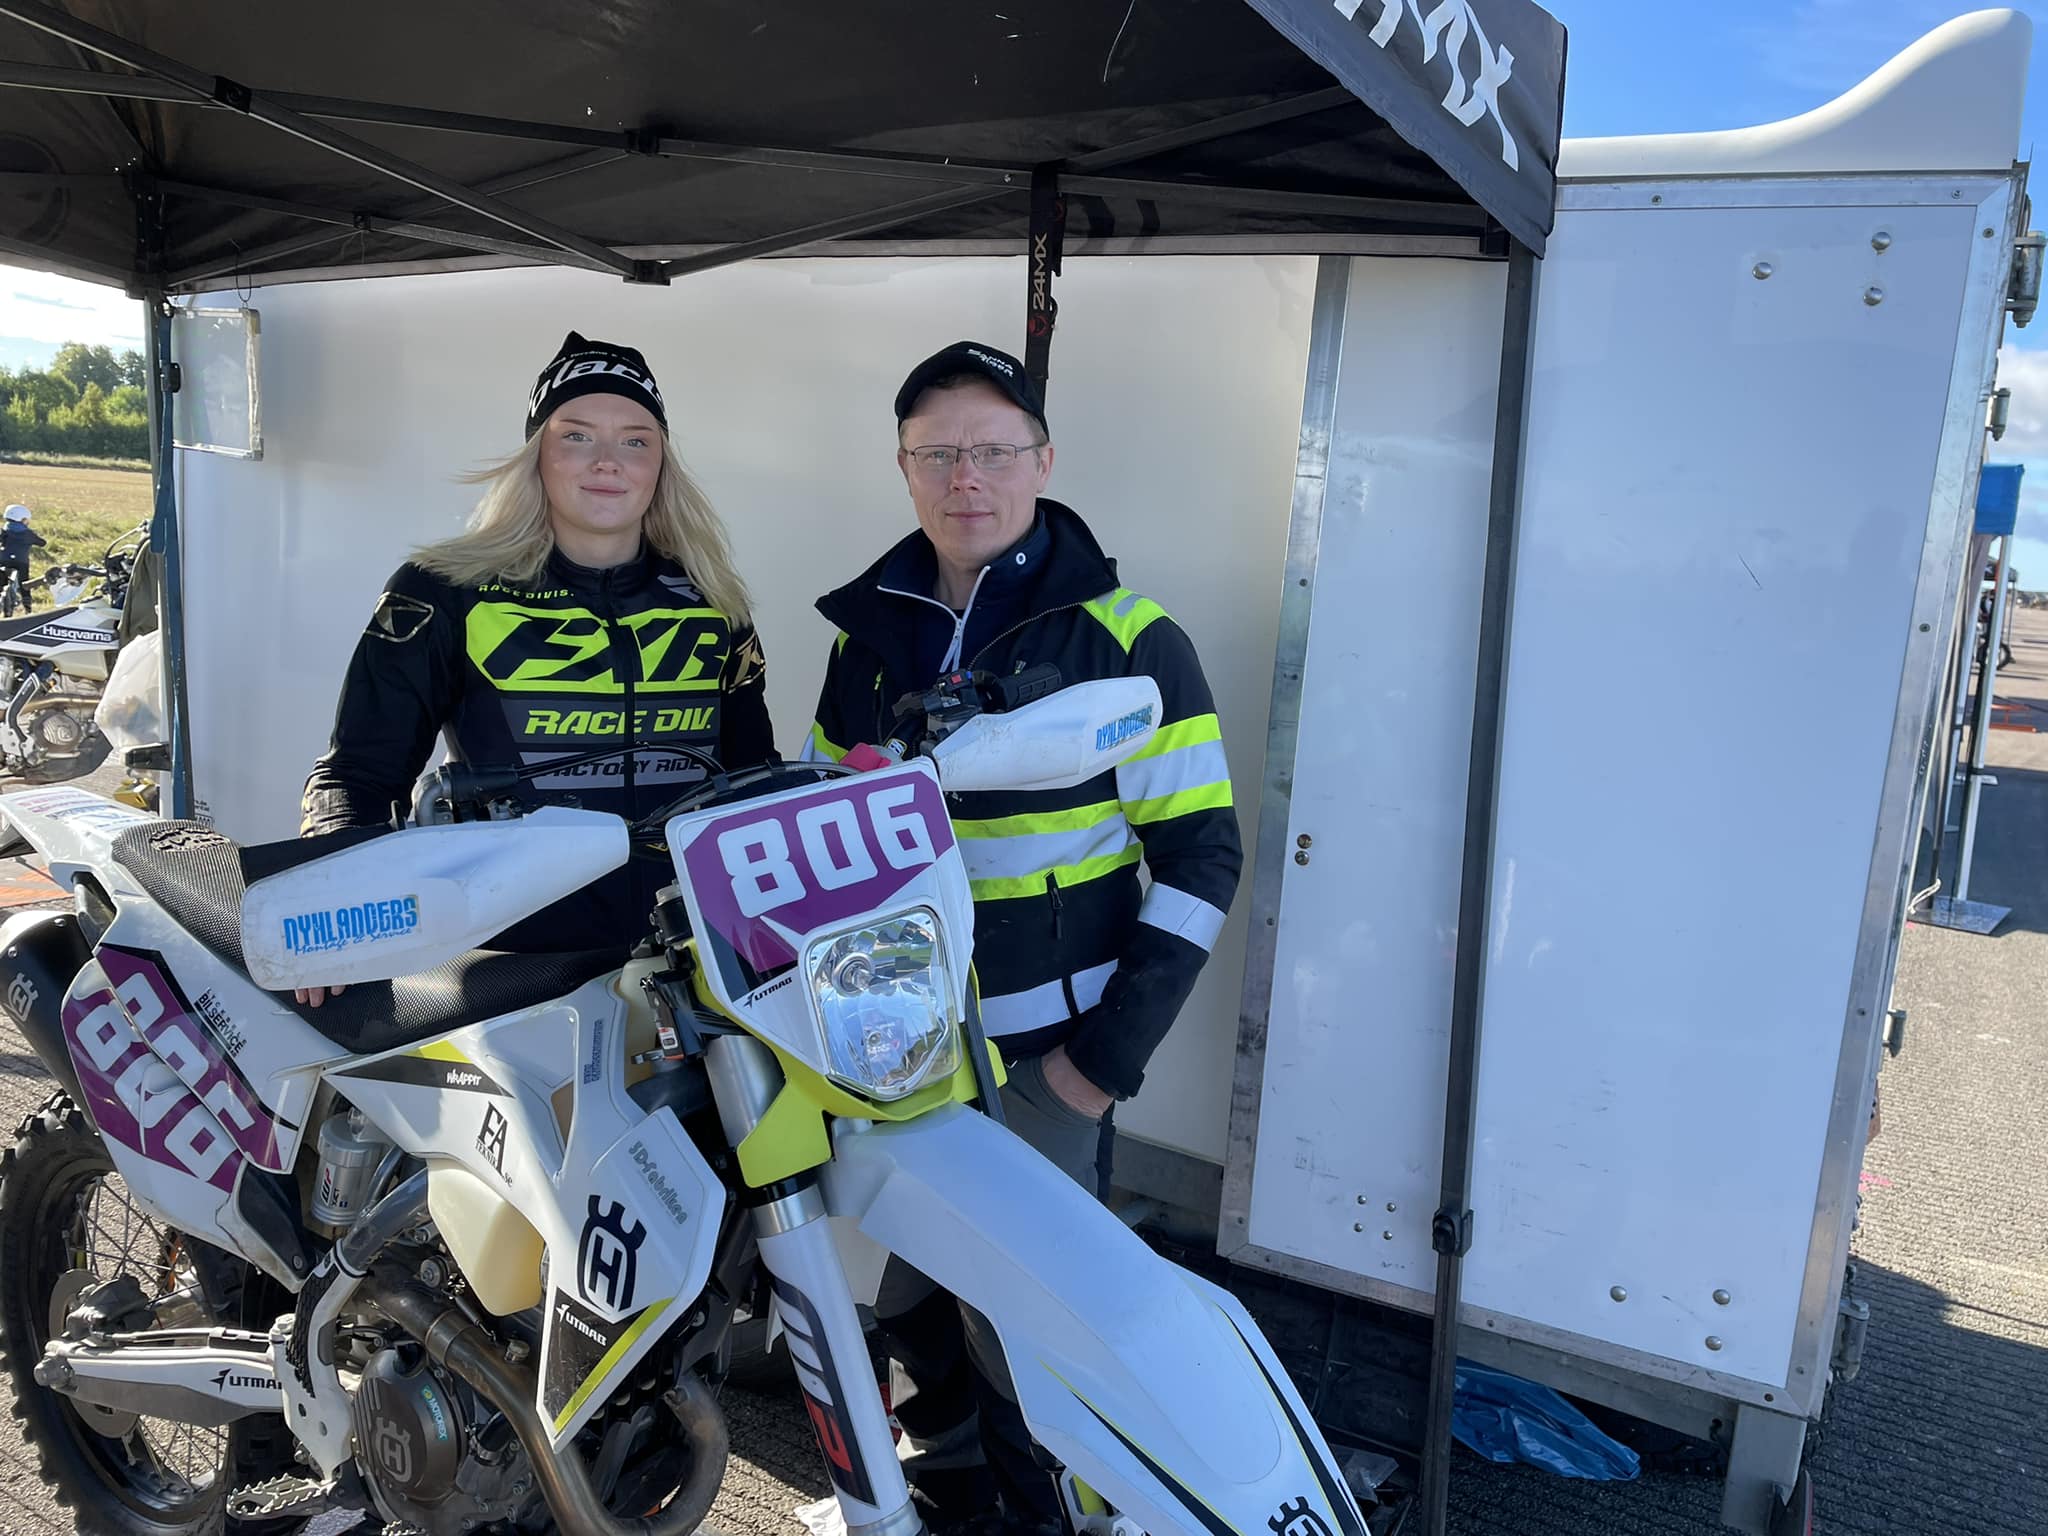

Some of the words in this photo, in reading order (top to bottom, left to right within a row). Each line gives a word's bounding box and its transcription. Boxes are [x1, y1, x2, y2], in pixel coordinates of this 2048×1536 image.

[1333, 0, 1519, 173] MX
[1032, 232, 1048, 311] 24MX
[528, 359, 664, 418] olari
[478, 584, 520, 597] RACE
[42, 625, 112, 642] Husqvarna
[524, 709, 648, 735] RACE
[653, 706, 715, 732] DIV.
[553, 760, 652, 777] ACTOY
[716, 783, 938, 920] 806
[198, 992, 243, 1054] BILSERVICE
[428, 1397, 448, 1440] MOTOREX
